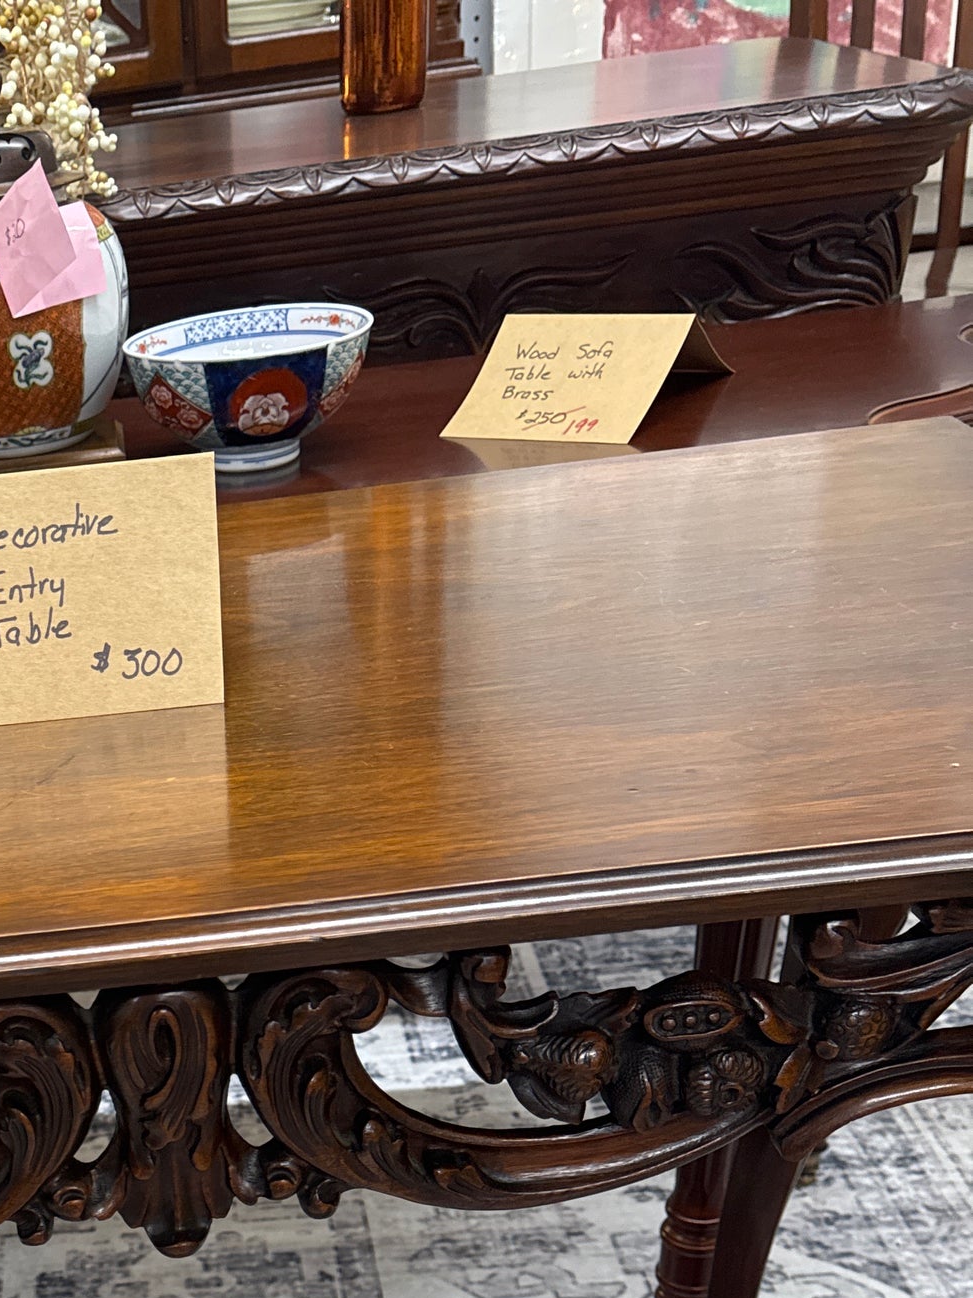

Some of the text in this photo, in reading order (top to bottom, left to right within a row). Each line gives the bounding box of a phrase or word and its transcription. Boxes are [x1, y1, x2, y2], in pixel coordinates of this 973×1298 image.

[515, 340, 614, 360] Wood Sofa
[504, 362, 606, 381] Table with
[501, 385, 555, 401] Brass
[515, 408, 600, 436] $250 199
